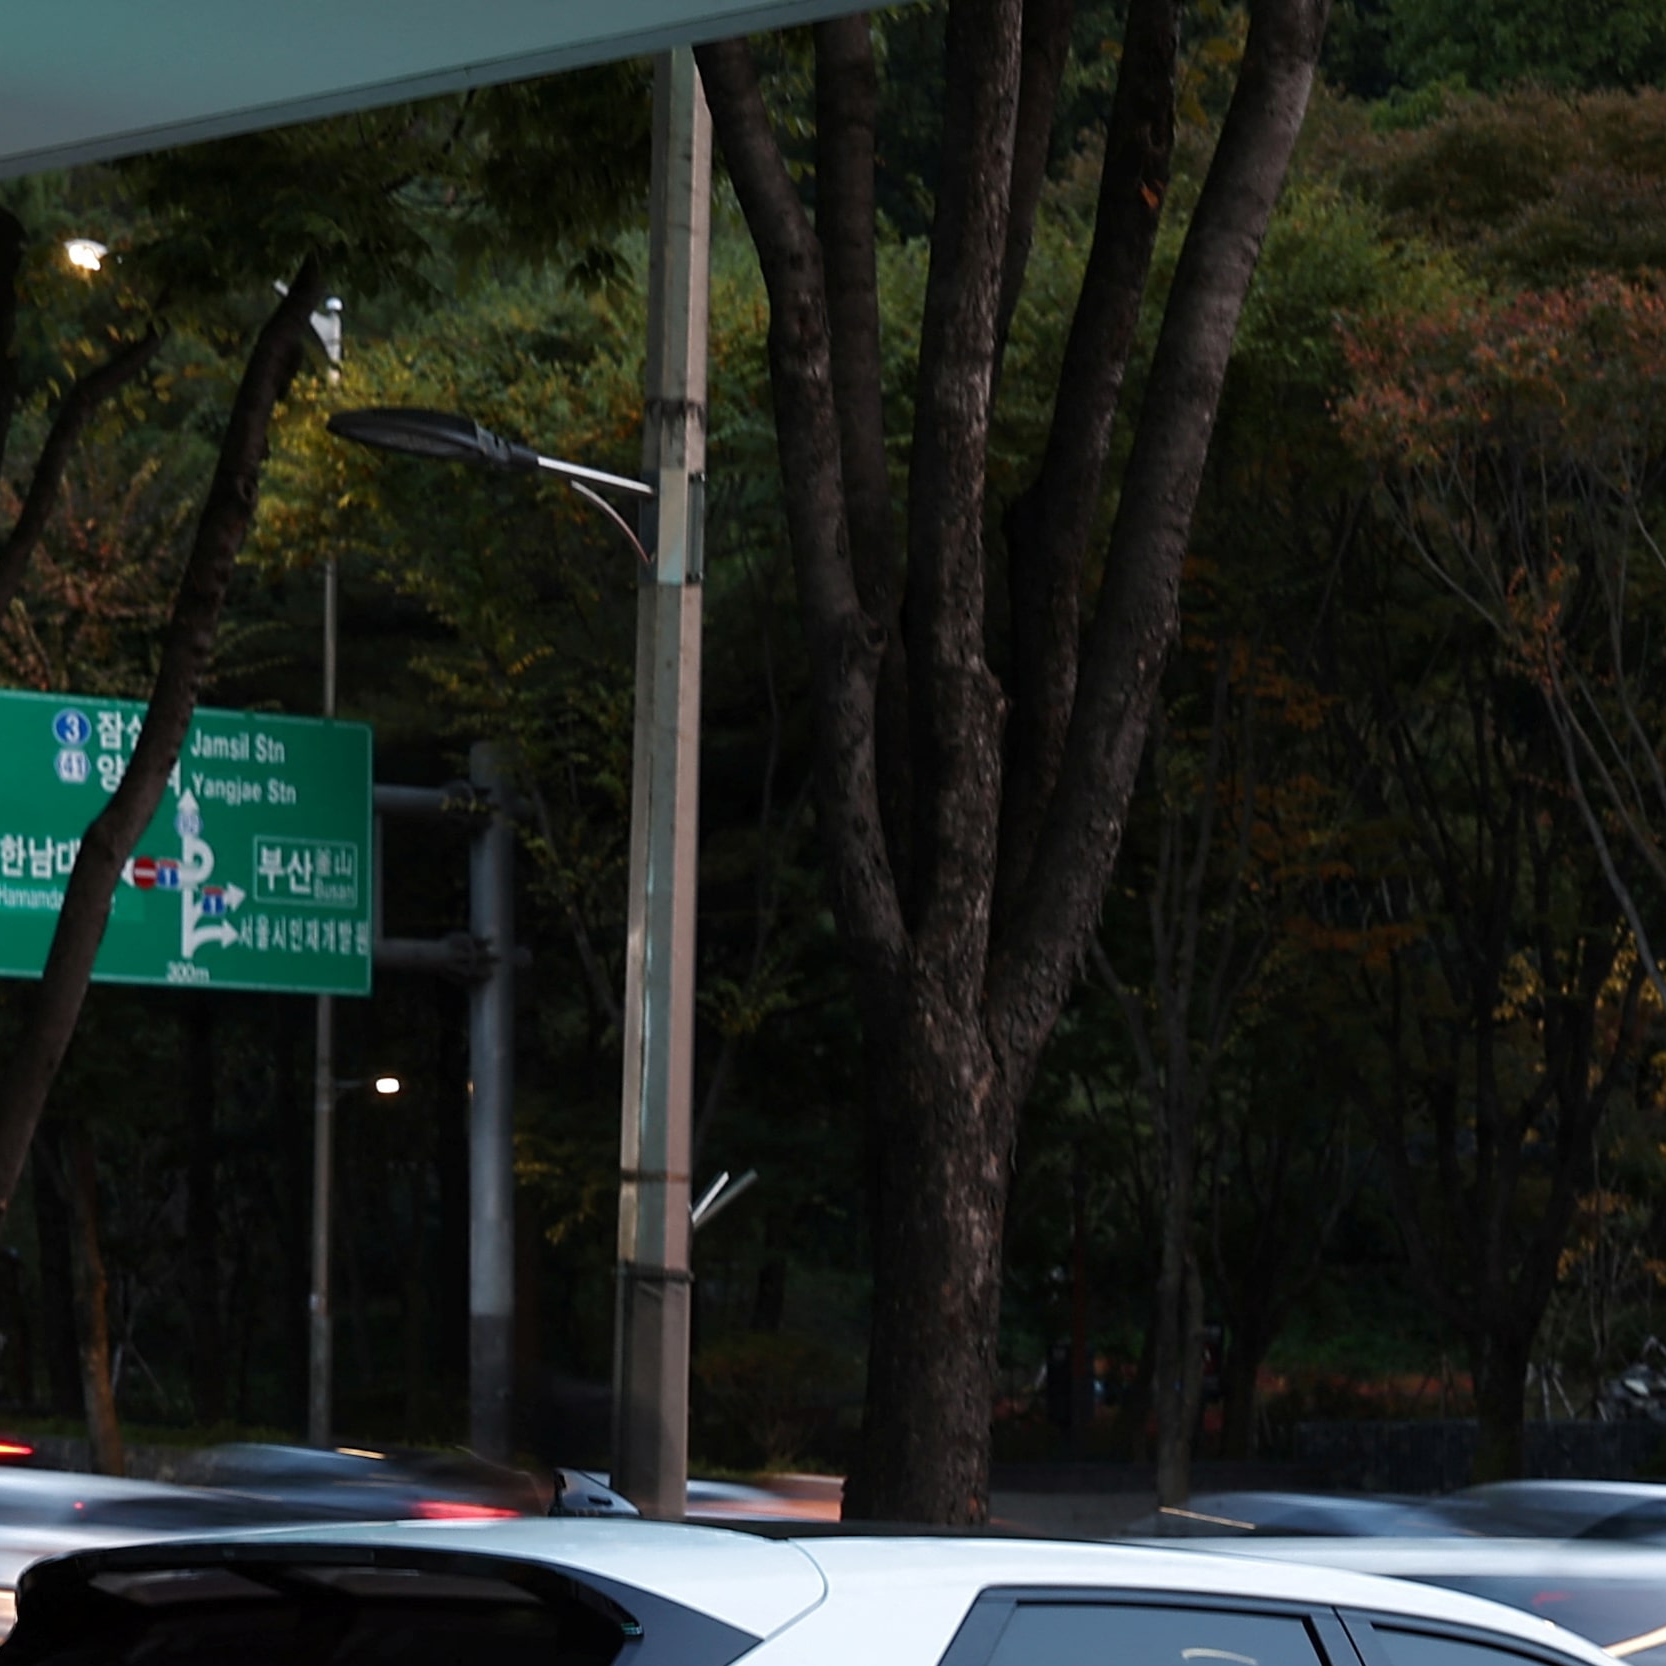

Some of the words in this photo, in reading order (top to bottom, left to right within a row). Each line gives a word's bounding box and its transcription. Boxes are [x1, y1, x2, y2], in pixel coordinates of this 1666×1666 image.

[65, 712, 81, 744] 3
[191, 728, 250, 761] Jamsil
[255, 733, 286, 764] Stn
[192, 772, 263, 806] Yangjae
[268, 778, 297, 805] Stn
[257, 846, 314, 895] 부산
